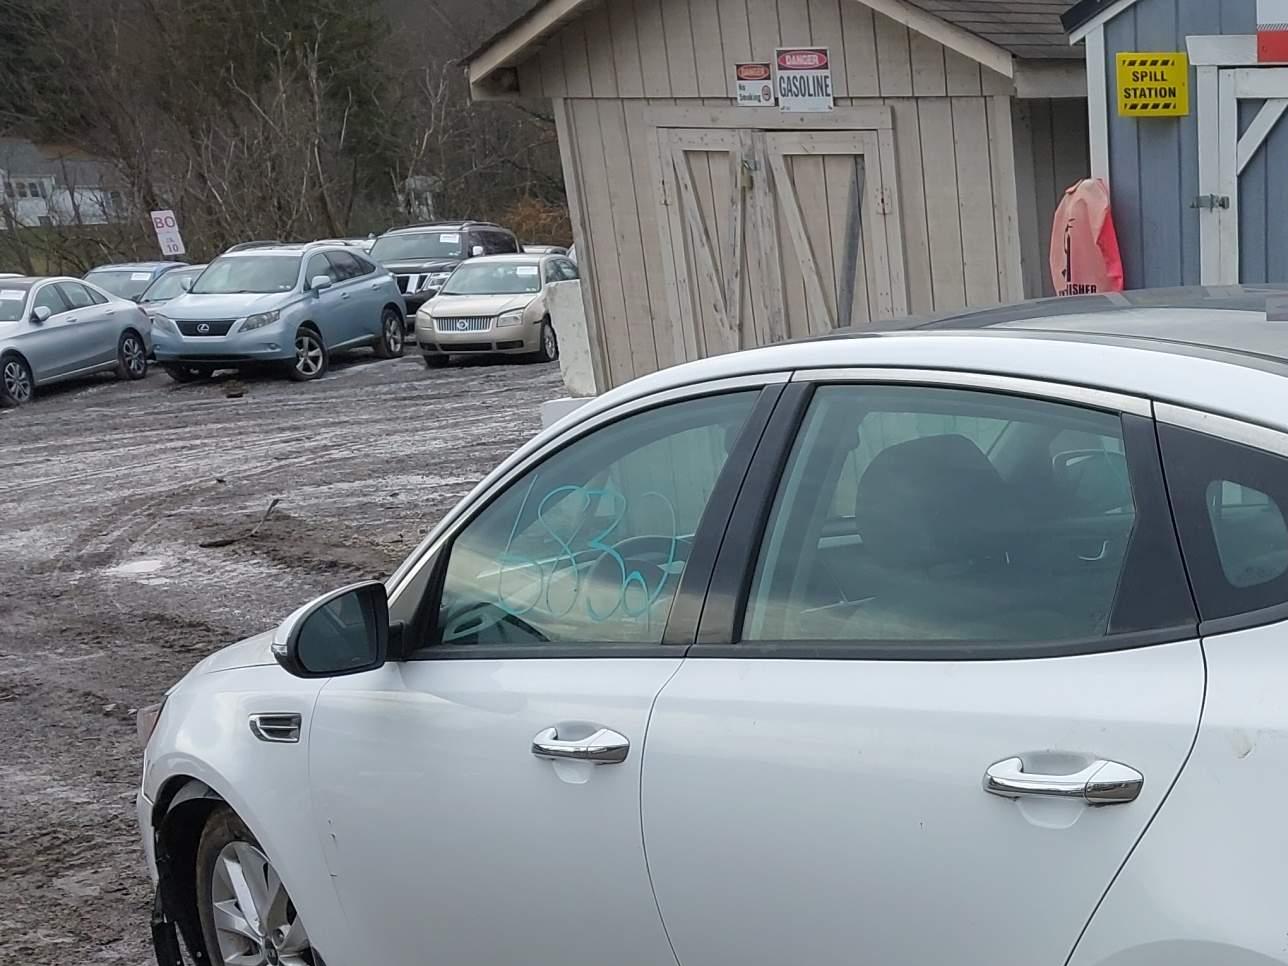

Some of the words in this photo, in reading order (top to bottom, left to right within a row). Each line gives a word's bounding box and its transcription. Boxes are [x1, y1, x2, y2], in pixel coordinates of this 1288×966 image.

[784, 54, 820, 66] DANGER
[1131, 70, 1169, 82] SPILL
[778, 74, 831, 98] GASOLINE
[1123, 87, 1177, 99] STATION
